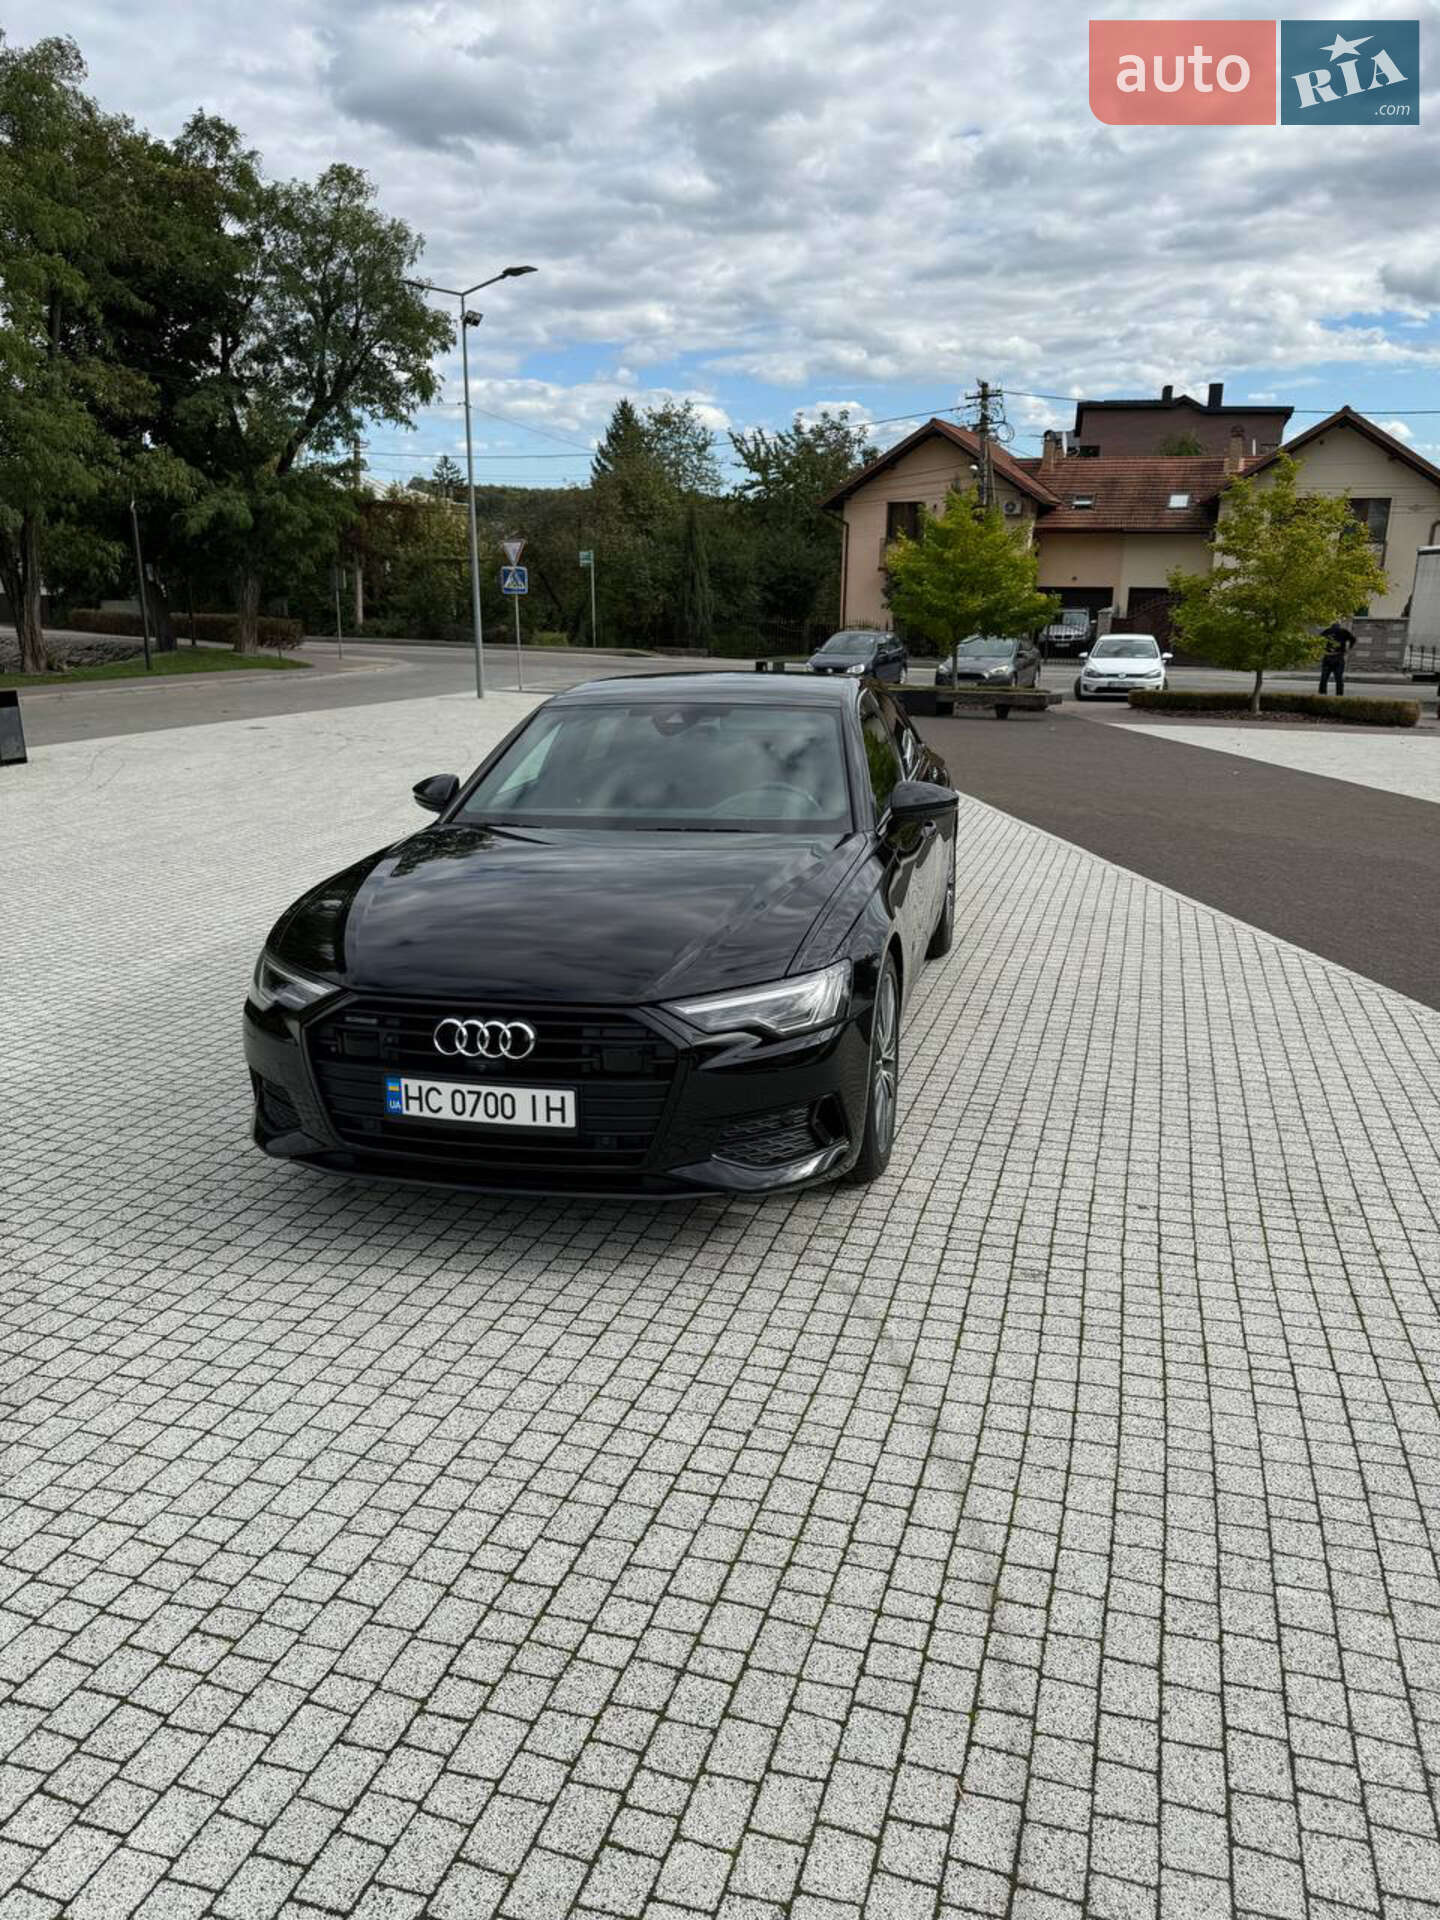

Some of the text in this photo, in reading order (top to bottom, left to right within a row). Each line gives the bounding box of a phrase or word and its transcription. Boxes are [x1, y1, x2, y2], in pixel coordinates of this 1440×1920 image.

[389, 1100, 401, 1110] UA
[404, 1083, 566, 1124] HC 0700 IH
